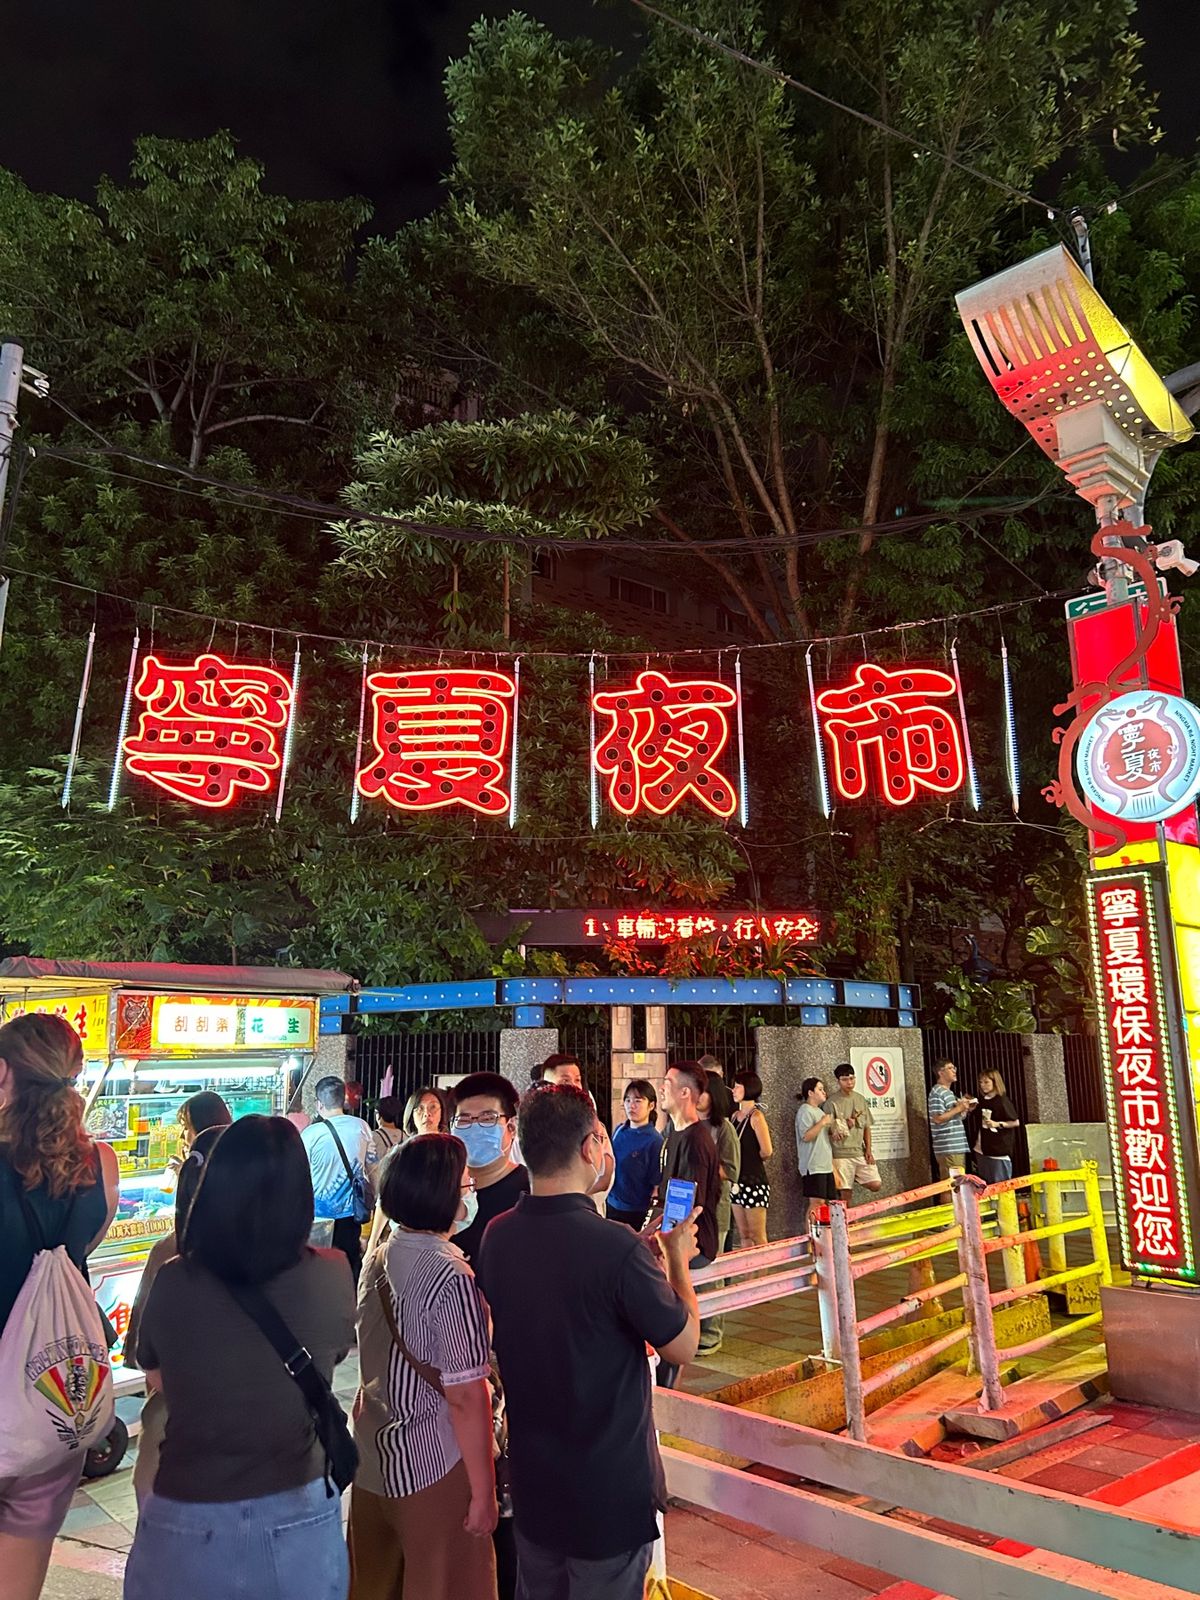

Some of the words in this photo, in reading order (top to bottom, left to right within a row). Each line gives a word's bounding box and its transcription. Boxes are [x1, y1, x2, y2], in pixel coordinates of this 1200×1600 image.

[122, 653, 965, 819] 寧夏夜市
[1116, 722, 1157, 783] 寧夏
[1148, 748, 1163, 773] 夜市
[251, 1017, 300, 1034] 花生
[1100, 888, 1177, 1256] 寧夏環保夜市歡迎您
